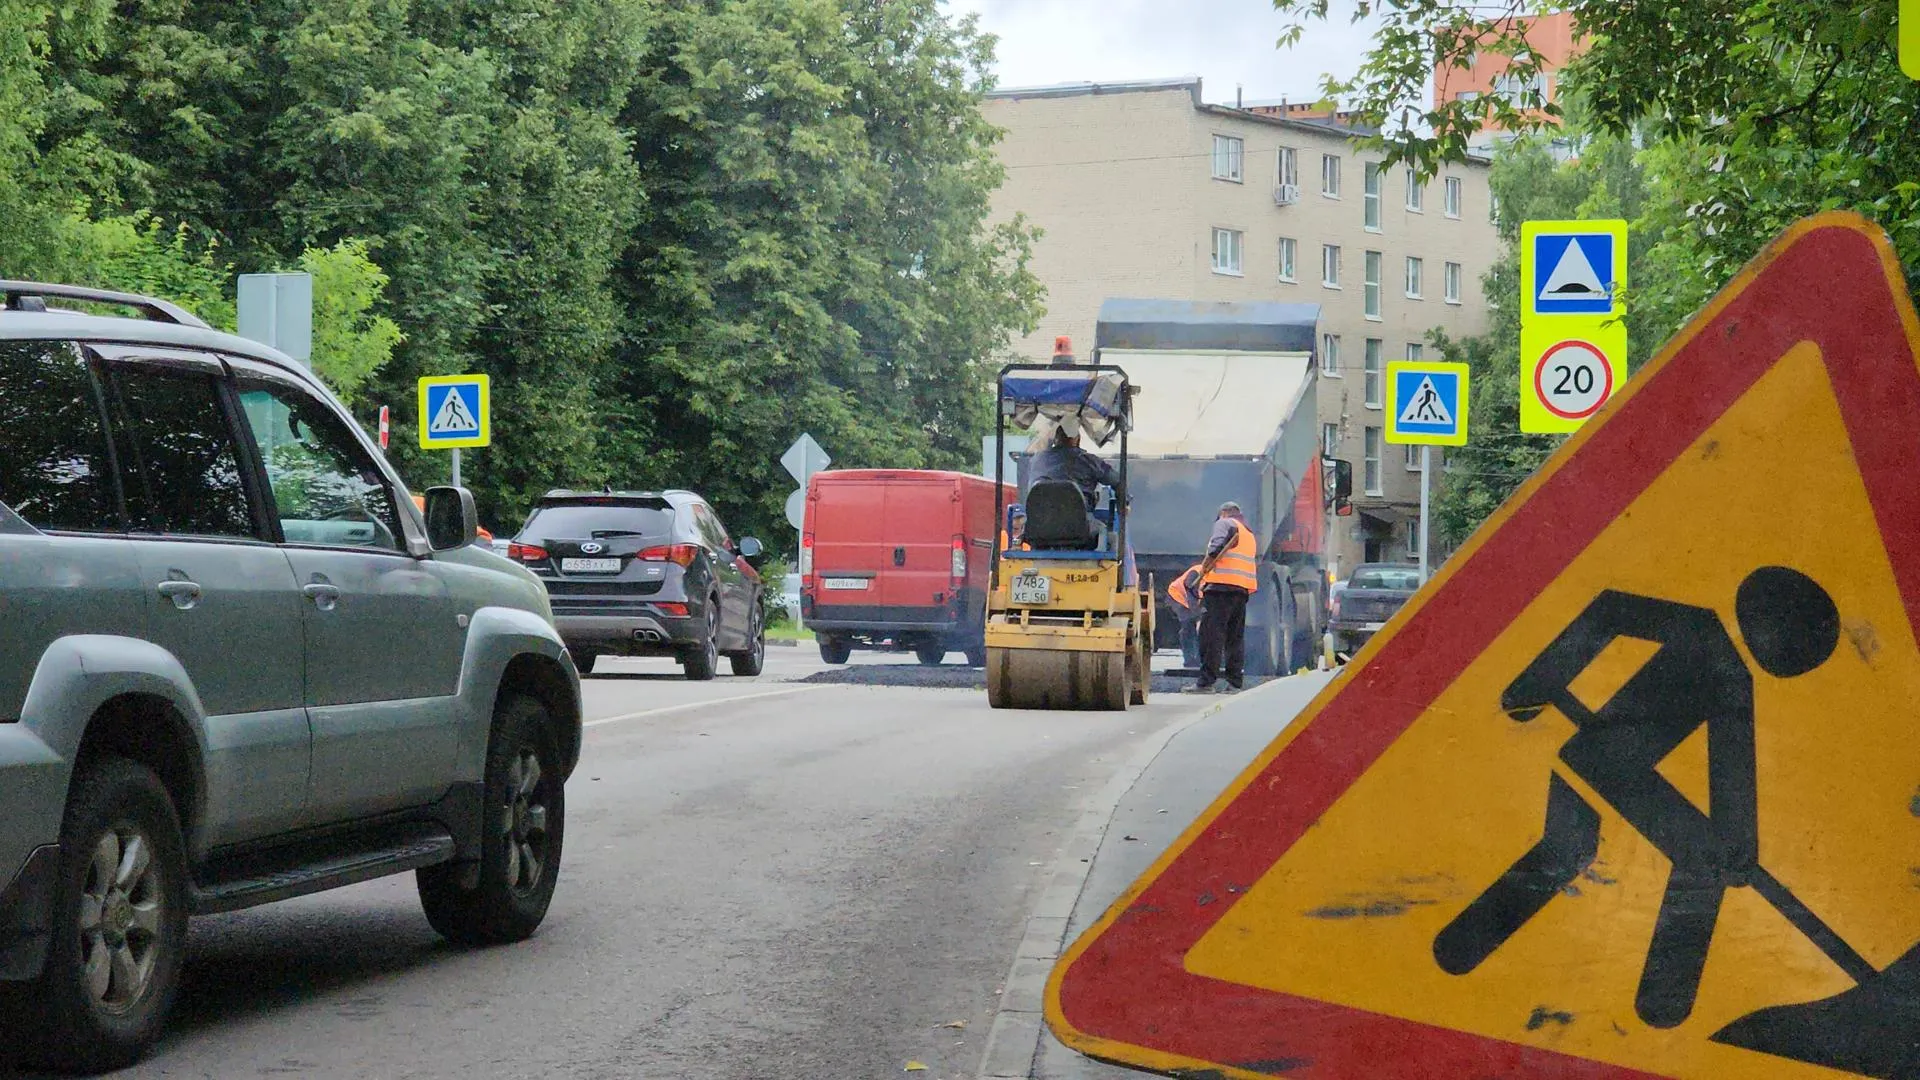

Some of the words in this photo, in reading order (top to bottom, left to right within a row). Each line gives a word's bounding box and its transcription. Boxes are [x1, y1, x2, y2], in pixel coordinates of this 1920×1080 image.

[1553, 365, 1593, 394] 20
[1016, 576, 1045, 588] 7482
[1034, 593, 1046, 601] 50
